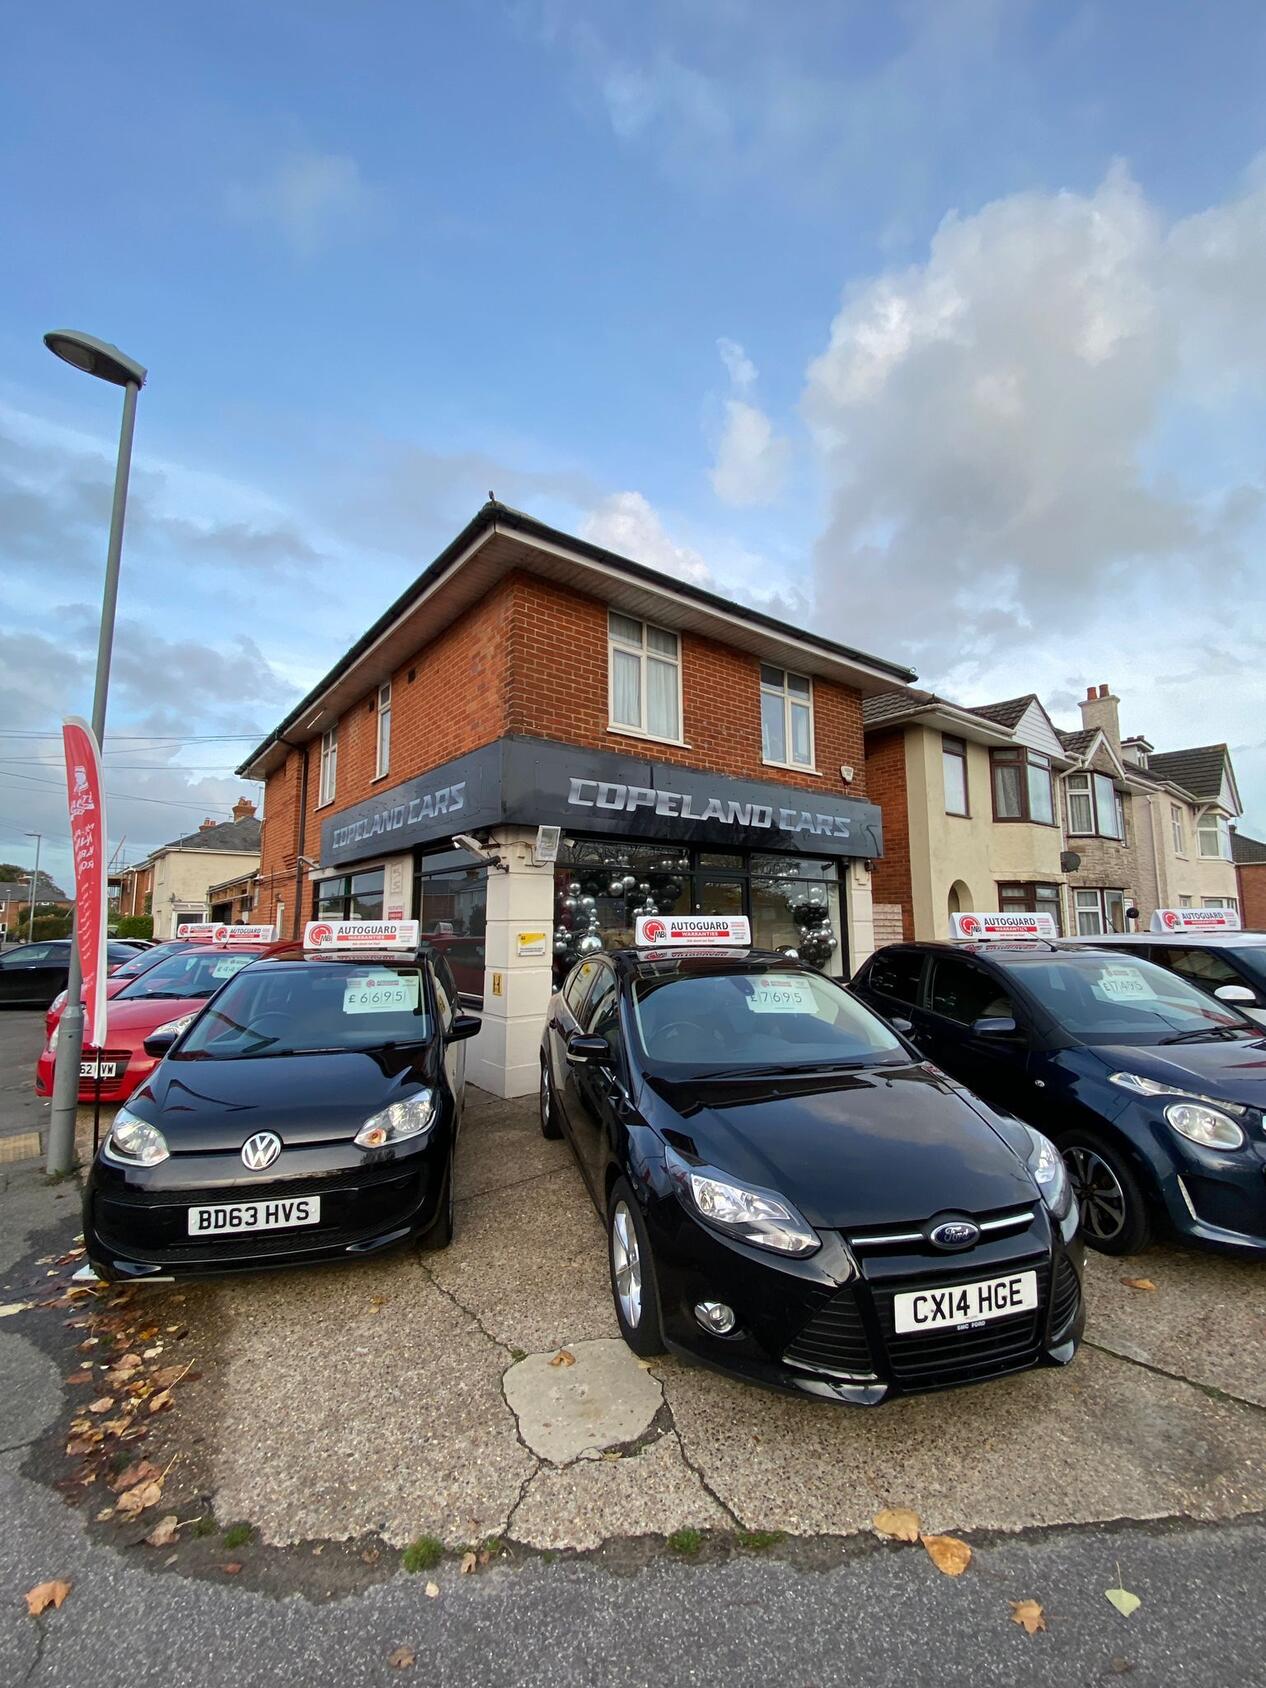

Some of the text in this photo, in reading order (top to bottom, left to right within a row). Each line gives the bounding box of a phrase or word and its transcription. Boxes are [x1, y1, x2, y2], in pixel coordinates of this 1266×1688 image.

[567, 777, 850, 838] COPELAND CARS
[332, 781, 466, 849] COPELAND CARS
[984, 917, 1036, 926] AUTOGUARD
[1182, 912, 1223, 920] AUTOGUARD
[337, 925, 397, 935] AUTOGUARD
[671, 922, 729, 931] AUTOGUARD
[348, 991, 403, 1004] £6695
[750, 991, 802, 1003] £7695
[198, 1201, 310, 1231] BD63 HVS
[944, 1226, 970, 1242] Ford
[913, 1278, 1023, 1324] CX14 HGE
